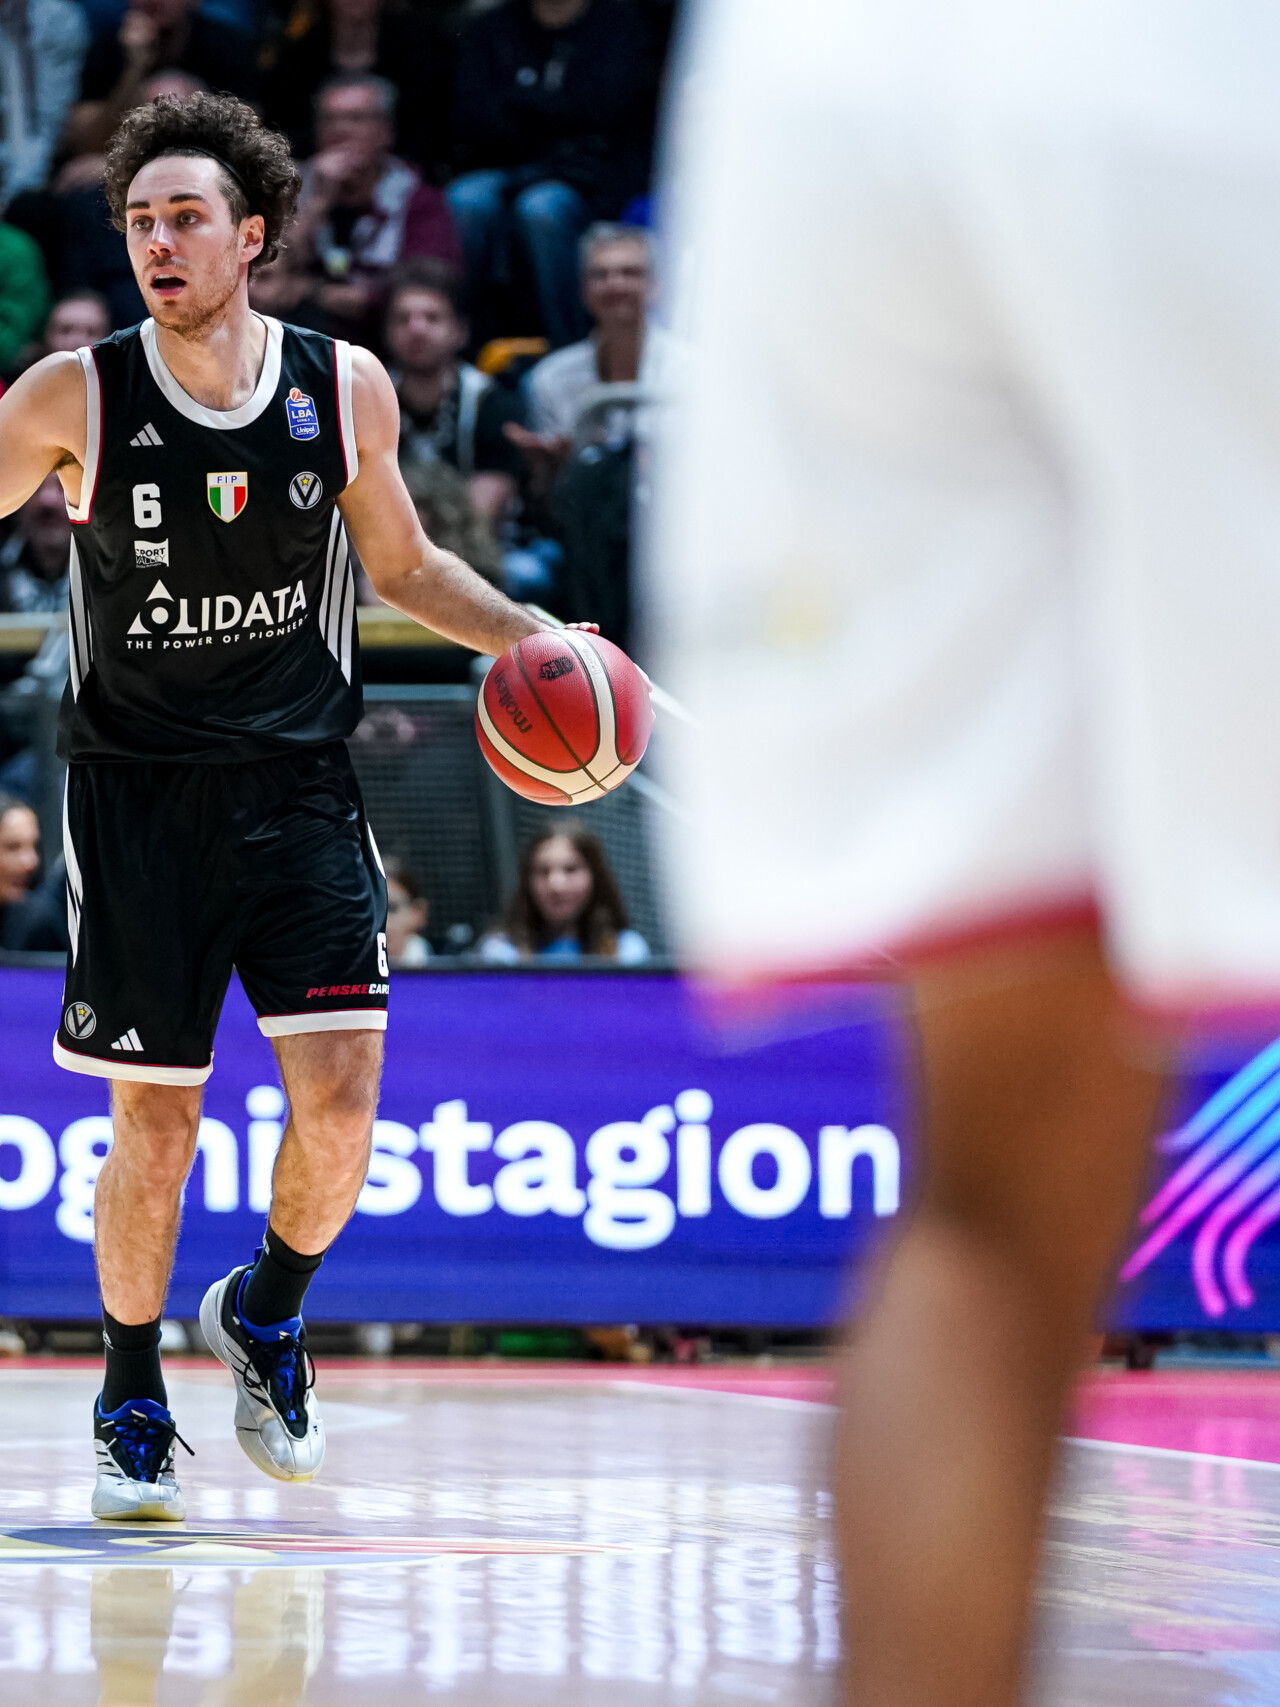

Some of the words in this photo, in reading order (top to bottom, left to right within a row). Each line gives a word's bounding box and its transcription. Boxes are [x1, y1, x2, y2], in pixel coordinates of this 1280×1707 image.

[291, 409, 314, 419] LBA
[296, 426, 315, 435] Unipol
[217, 475, 238, 484] FIP
[132, 482, 163, 529] 6
[135, 548, 166, 557] SPORT
[136, 554, 166, 566] VALLEY
[126, 640, 153, 650] THE
[163, 636, 213, 650] POWER
[222, 634, 241, 644] OF
[494, 668, 534, 734] molten
